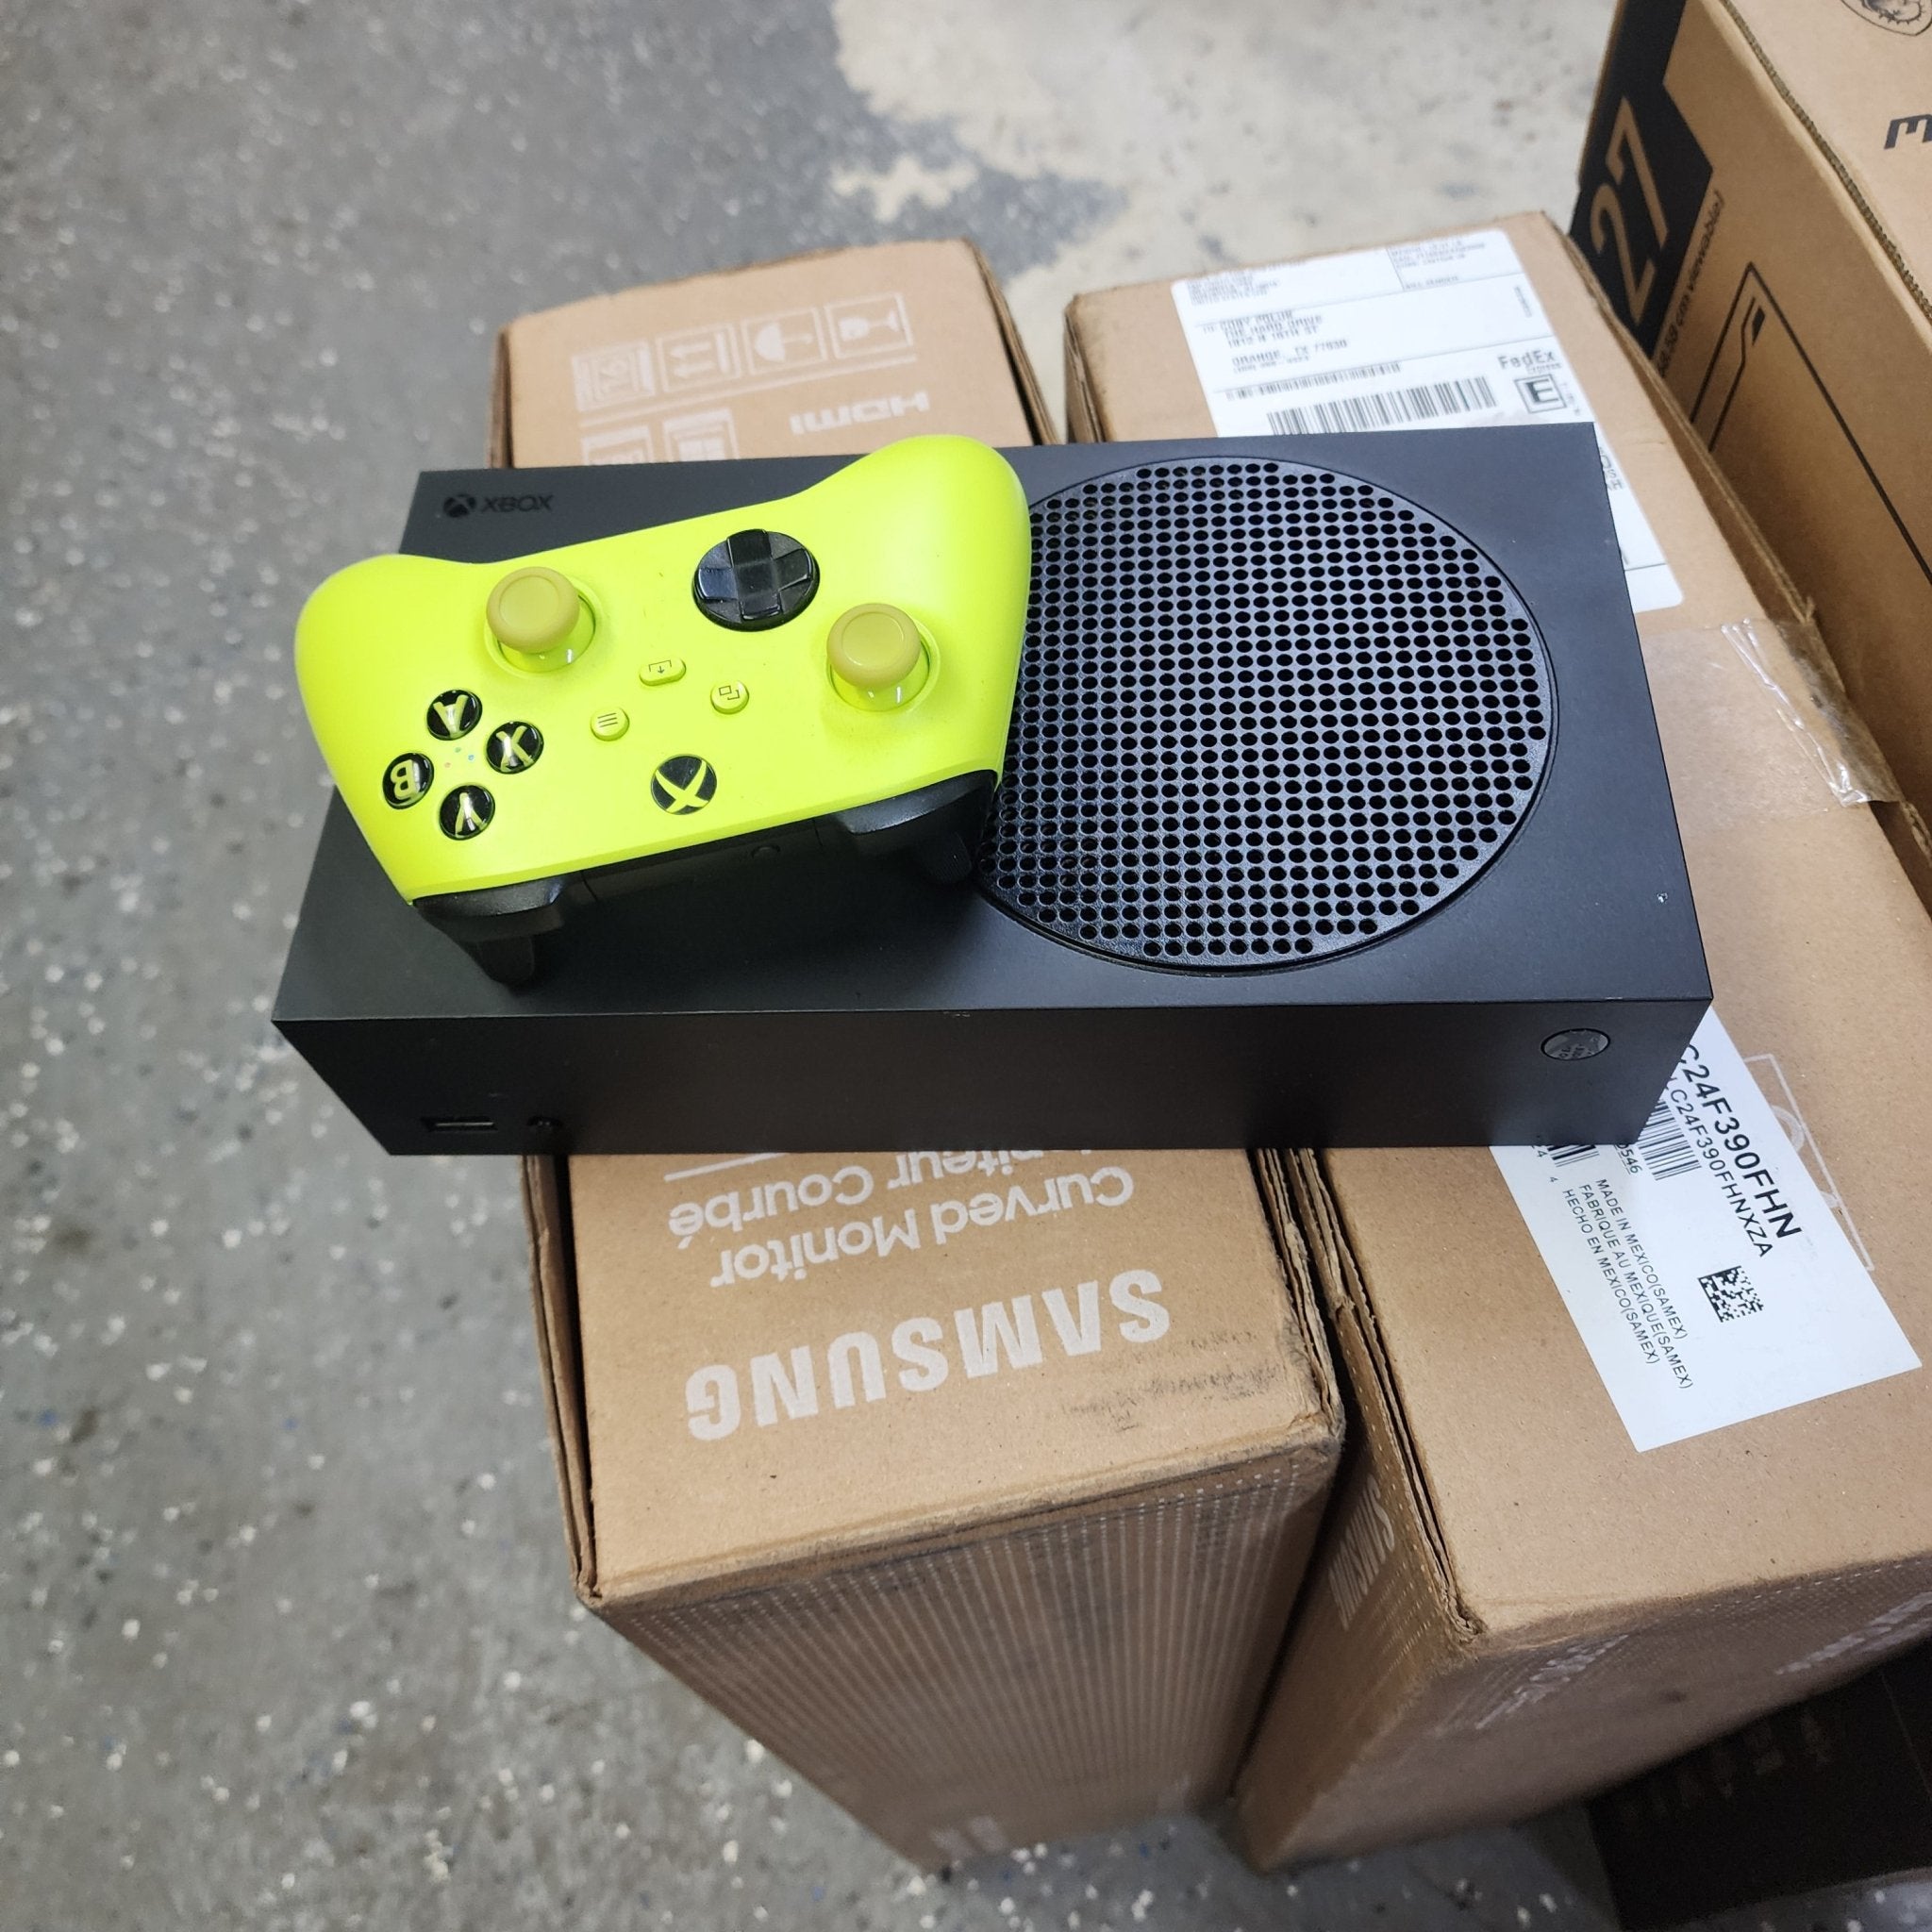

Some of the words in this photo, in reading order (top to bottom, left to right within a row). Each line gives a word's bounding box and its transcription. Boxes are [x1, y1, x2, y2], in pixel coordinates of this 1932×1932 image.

[1590, 96, 1668, 326] 27
[1498, 350, 1556, 369] FedEx
[789, 391, 930, 435] HDMI
[481, 495, 554, 512] XBOX
[433, 694, 469, 738] A
[496, 725, 535, 772] X
[390, 758, 424, 800] B
[455, 792, 488, 838] Y
[1666, 1077, 1774, 1257] C24F390FHNXZA
[1680, 1044, 1803, 1239] C24F390FHN
[668, 1165, 874, 1250] Courbé
[930, 1166, 1134, 1246] Curved
[710, 1208, 921, 1288] Monitor
[1562, 1189, 1593, 1234] HECHO
[1587, 1236, 1604, 1255] EN
[1597, 1257, 1661, 1365] MEXICO(SAMEX)
[1579, 1184, 1621, 1249] FABRIQUE
[1612, 1251, 1631, 1269] AU
[1624, 1271, 1693, 1390] MEXIQUE(SAMEX)
[1595, 1178, 1624, 1217] MADE
[1616, 1217, 1631, 1231] IN
[1624, 1233, 1689, 1340] MEXICO(SAMEX)
[685, 1270, 1171, 1441] SAMSUNG
